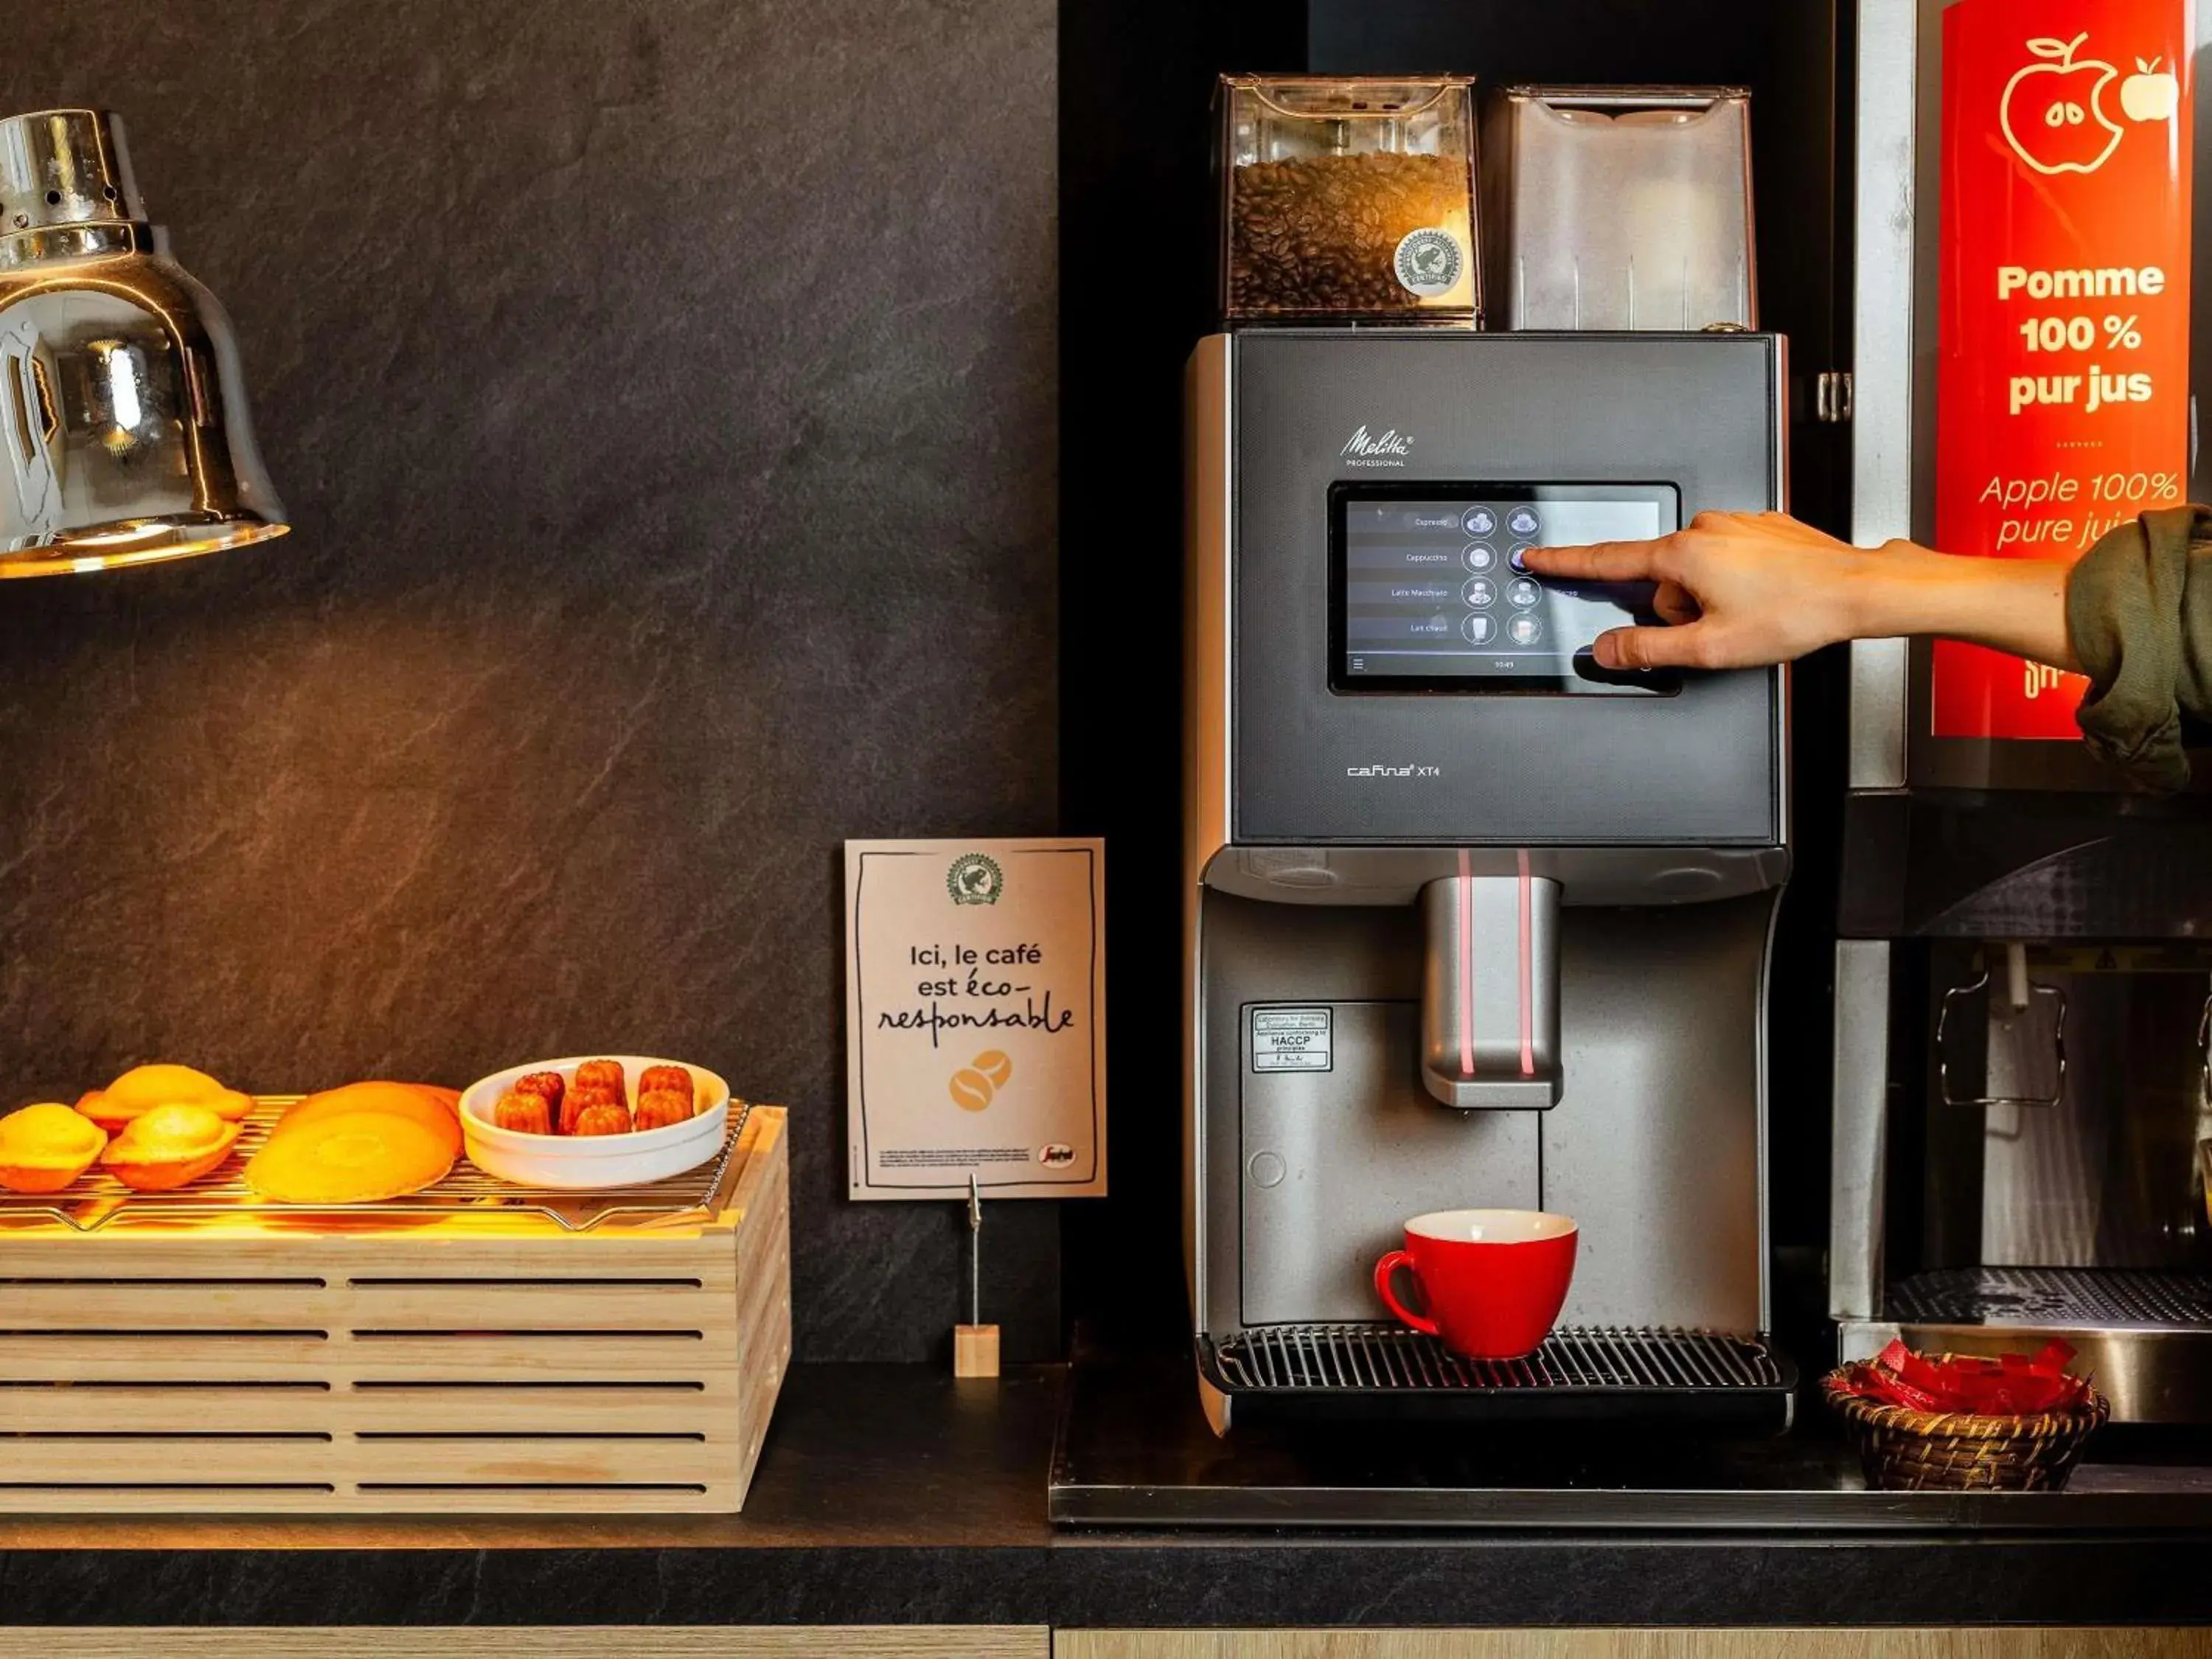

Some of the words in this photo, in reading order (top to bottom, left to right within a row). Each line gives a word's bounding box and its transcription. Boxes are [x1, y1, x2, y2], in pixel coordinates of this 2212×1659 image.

[1998, 266, 2165, 300] Pomme
[2020, 316, 2095, 352] 100
[2104, 314, 2142, 350] %
[2009, 375, 2081, 415] pur
[2084, 365, 2152, 414] jus
[1979, 472, 2079, 509] Apple
[2091, 472, 2179, 501] 100%
[1996, 519, 2073, 551] pure
[1416, 767, 1440, 776] XT4
[911, 944, 947, 968] Ici,
[956, 945, 978, 965] le
[985, 943, 1042, 964] café
[918, 978, 958, 996] est
[966, 967, 1031, 996] éco-
[878, 990, 1074, 1048] responsable
[1271, 1036, 1310, 1046] HACCP
